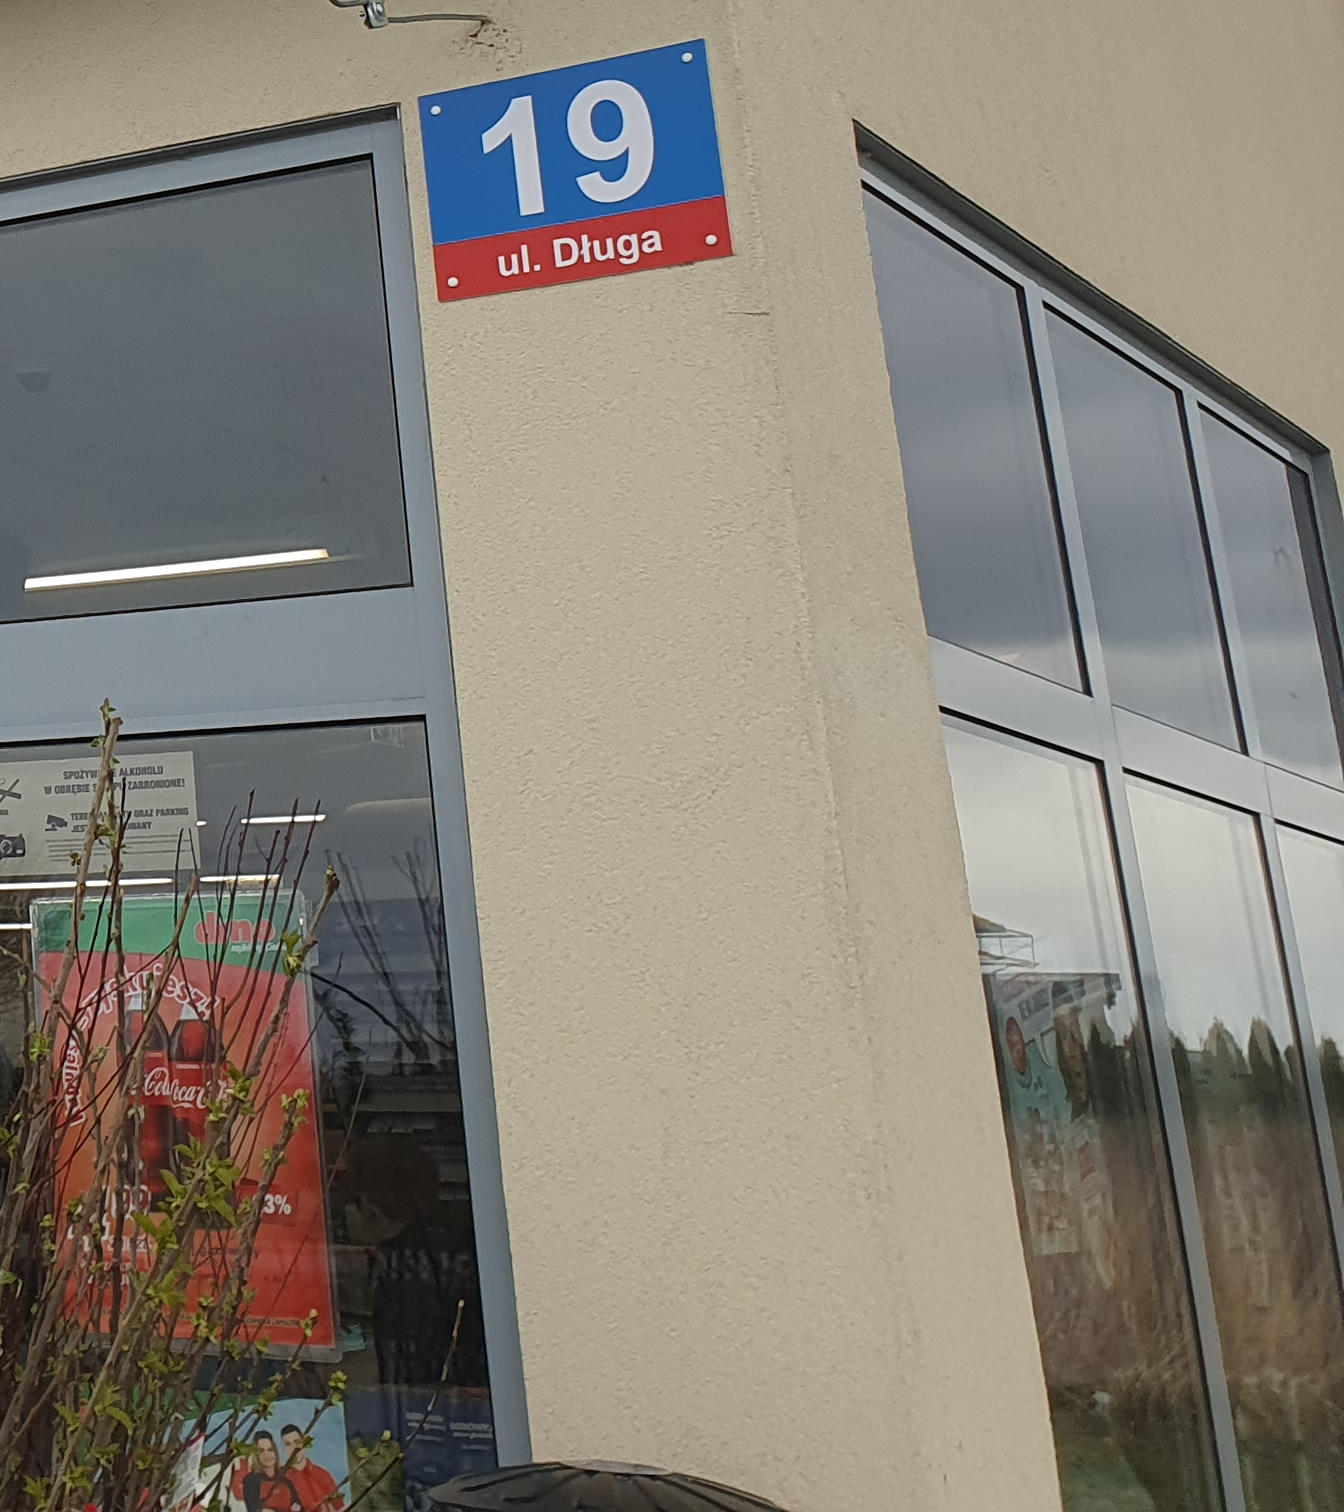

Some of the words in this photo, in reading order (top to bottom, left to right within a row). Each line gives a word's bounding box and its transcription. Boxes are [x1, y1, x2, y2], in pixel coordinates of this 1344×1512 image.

[481, 79, 654, 216] 19
[497, 244, 541, 277] ul.
[553, 230, 663, 266] Długa
[119, 765, 164, 777] ALKOHOLU
